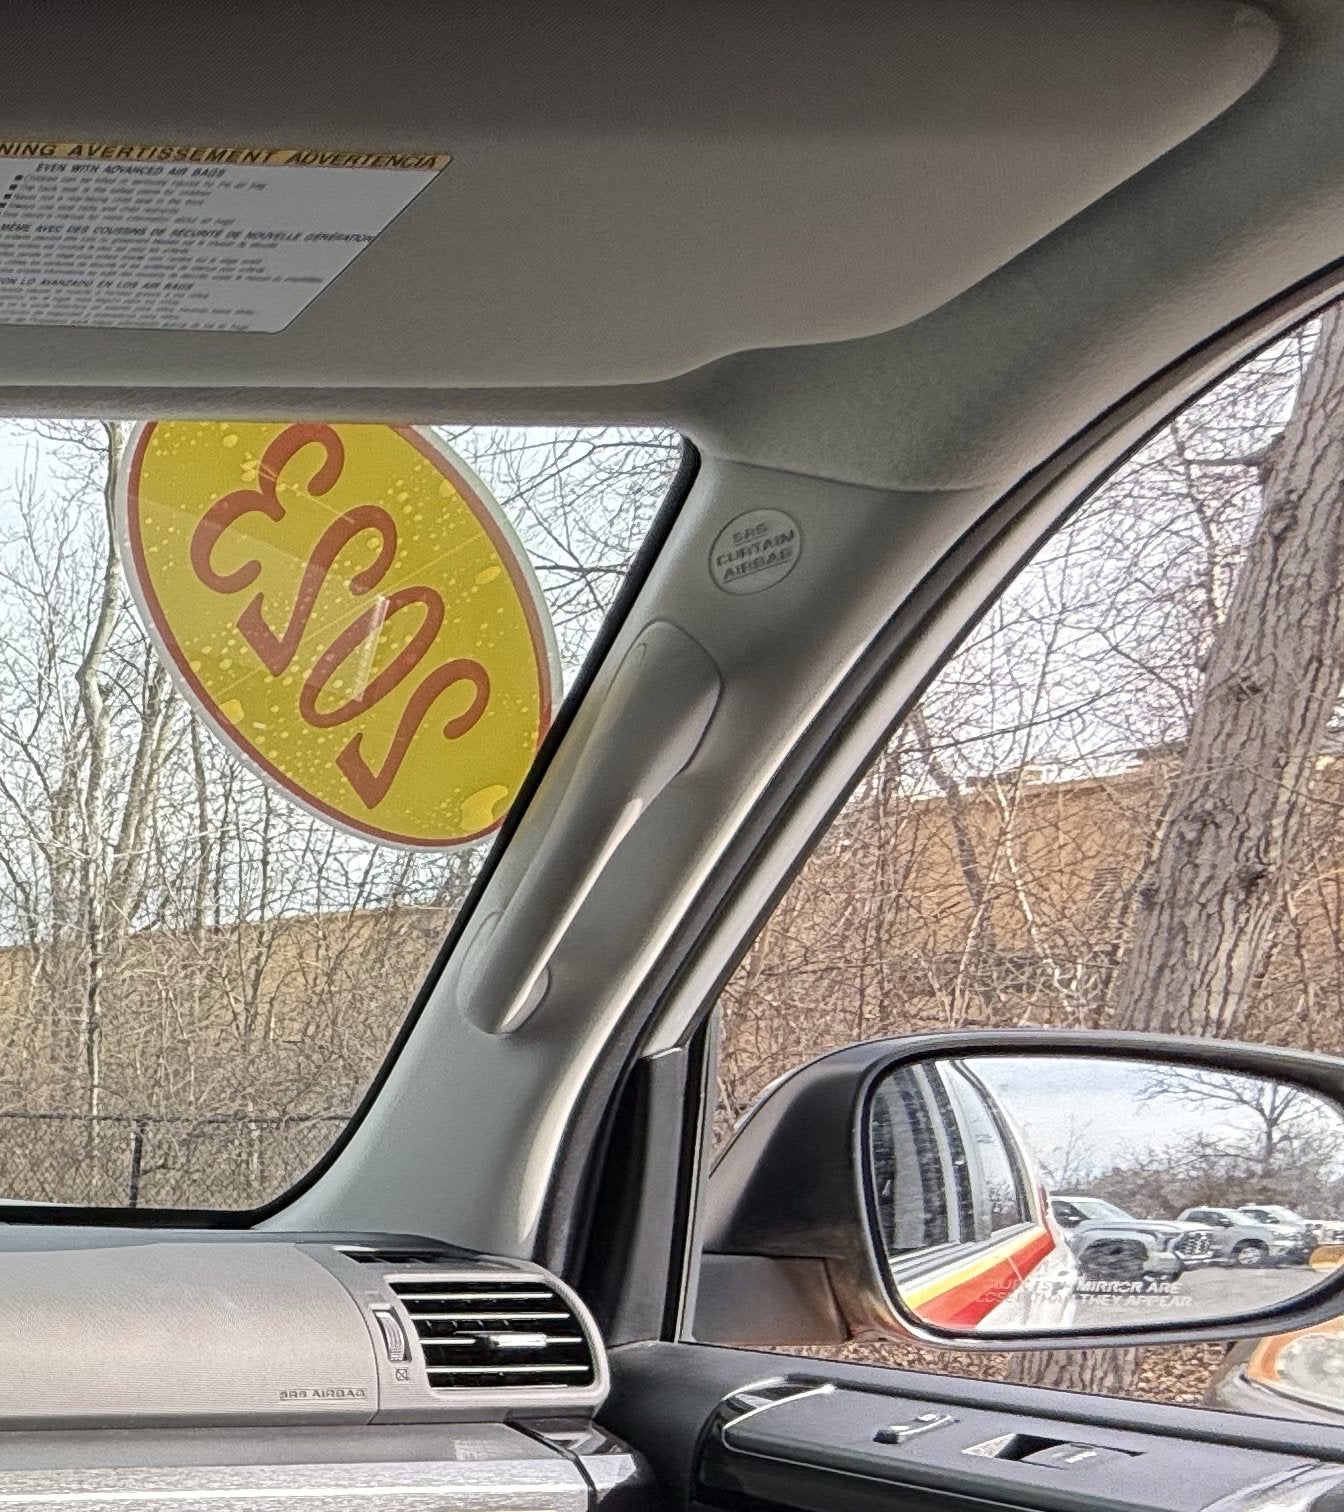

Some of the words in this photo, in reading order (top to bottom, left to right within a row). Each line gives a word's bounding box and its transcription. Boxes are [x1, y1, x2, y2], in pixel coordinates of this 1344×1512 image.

[67, 144, 278, 164] AVERTISSEMENT
[285, 151, 437, 168] ADVERTENCIA
[35, 163, 67, 173] EVEN
[70, 164, 99, 173] WITH
[1076, 1280, 1143, 1294] MIRROR
[1147, 1282, 1184, 1295] ARE
[1080, 1295, 1121, 1306] THEY
[1125, 1295, 1194, 1307] APPEAR
[312, 1388, 367, 1399] AIRBAG
